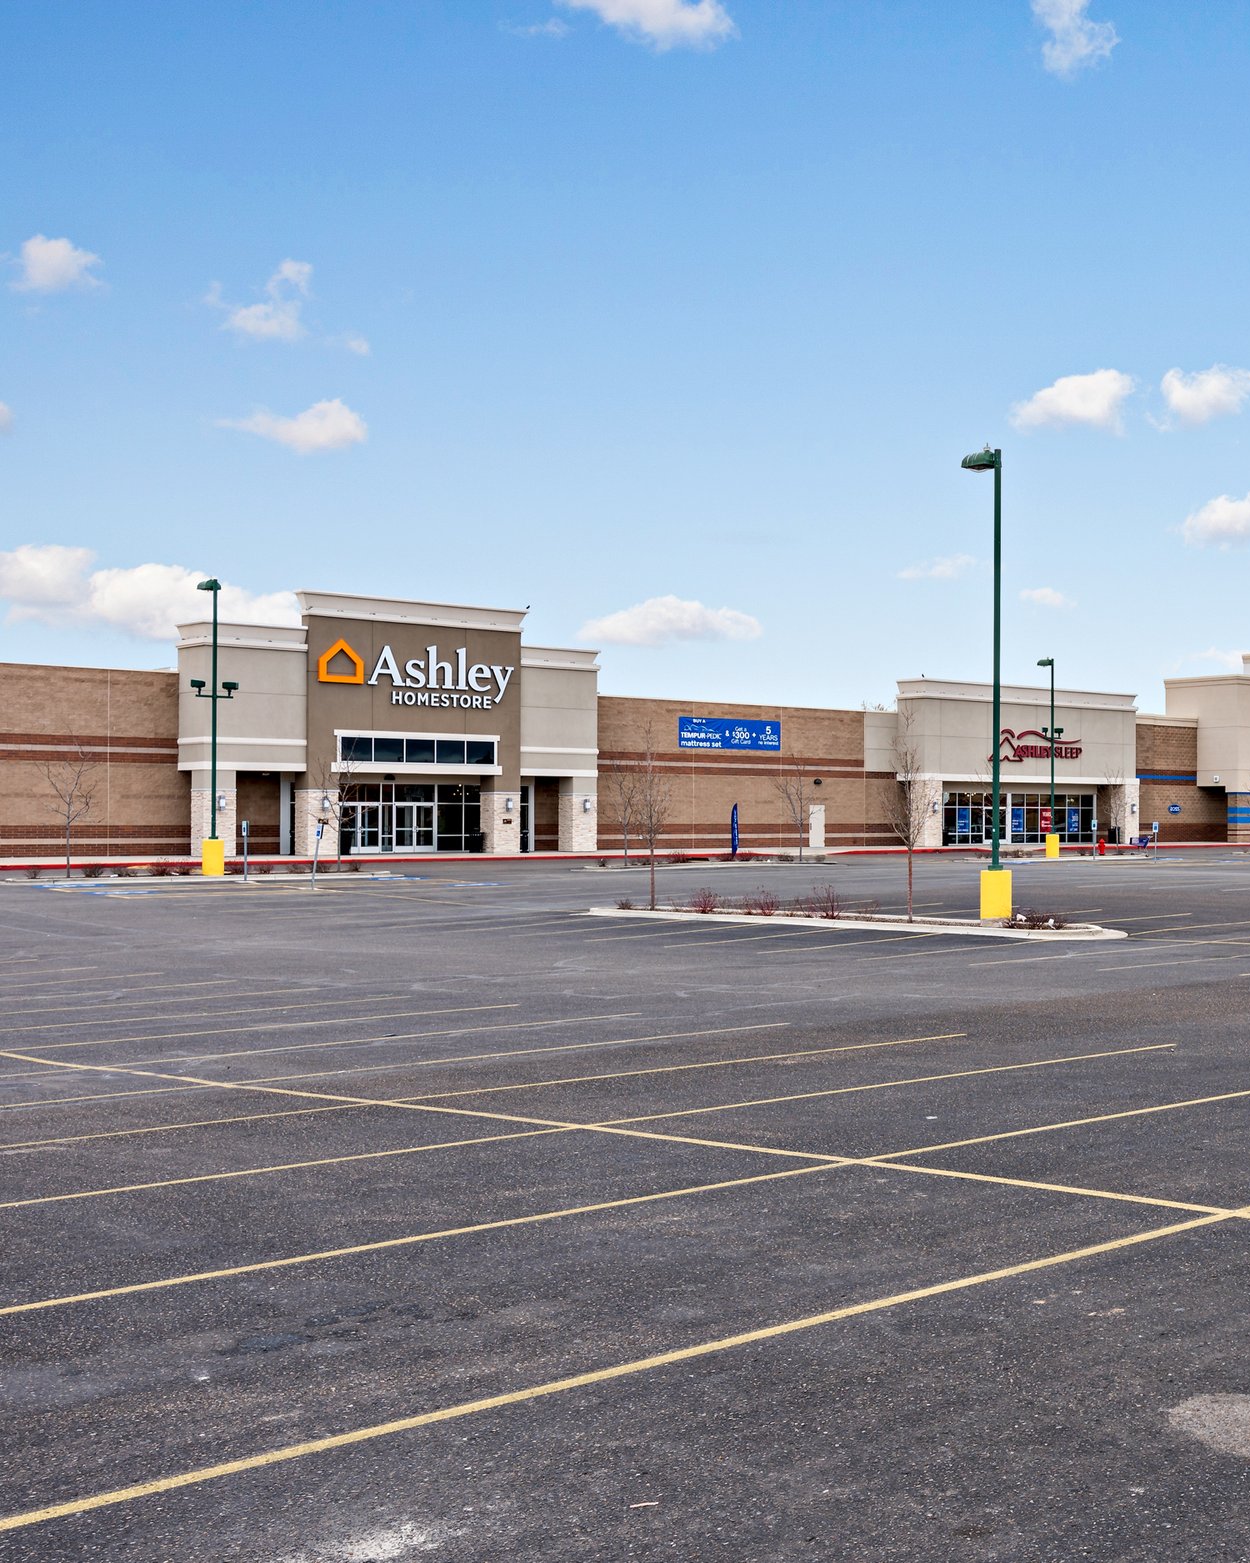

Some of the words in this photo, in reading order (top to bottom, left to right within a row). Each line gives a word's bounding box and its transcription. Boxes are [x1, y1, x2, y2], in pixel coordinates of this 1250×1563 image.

[367, 645, 514, 704] Ashley
[391, 691, 492, 709] HOMESTORE
[732, 731, 750, 740] $300
[765, 726, 772, 735] 5
[1013, 744, 1053, 759] ASHLEY
[1054, 746, 1083, 759] SLEEP
